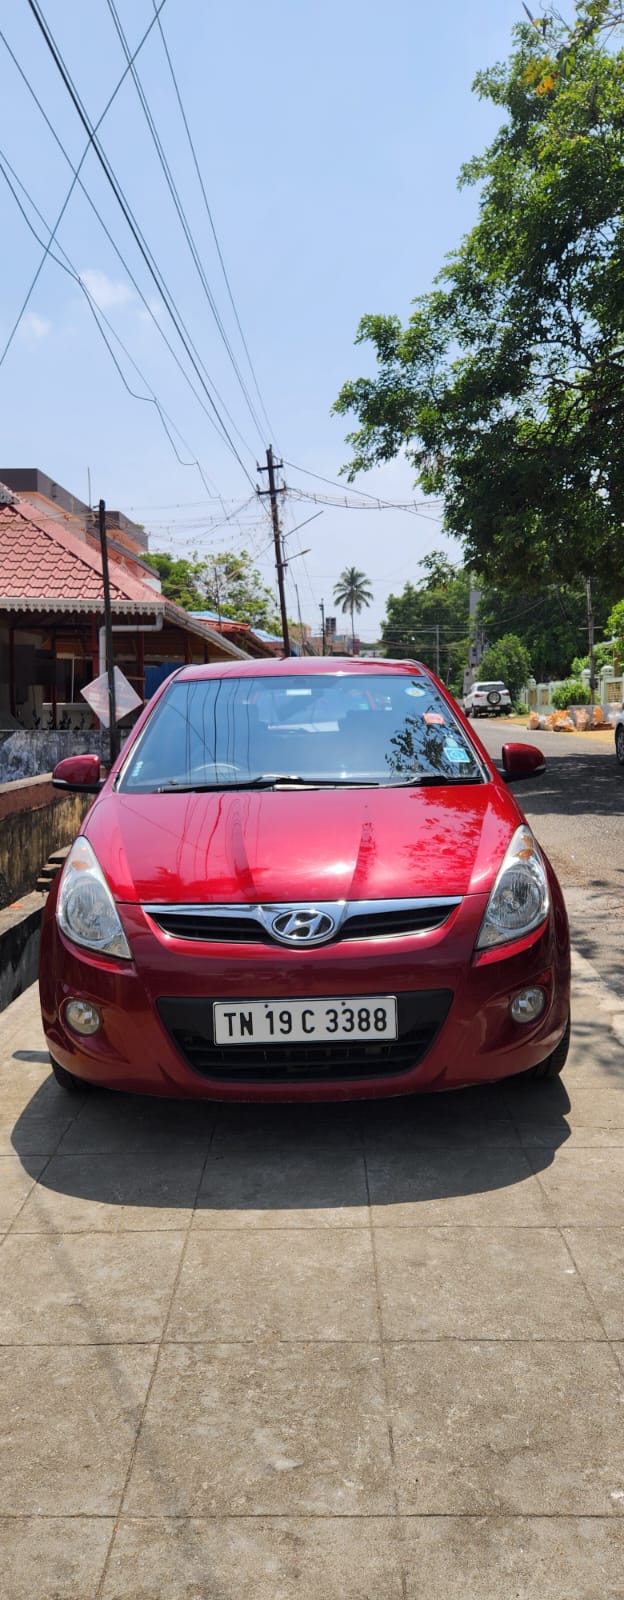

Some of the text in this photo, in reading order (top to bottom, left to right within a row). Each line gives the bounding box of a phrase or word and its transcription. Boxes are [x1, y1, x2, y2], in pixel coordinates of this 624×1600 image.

[223, 1007, 387, 1037] TN 19 C 3388
